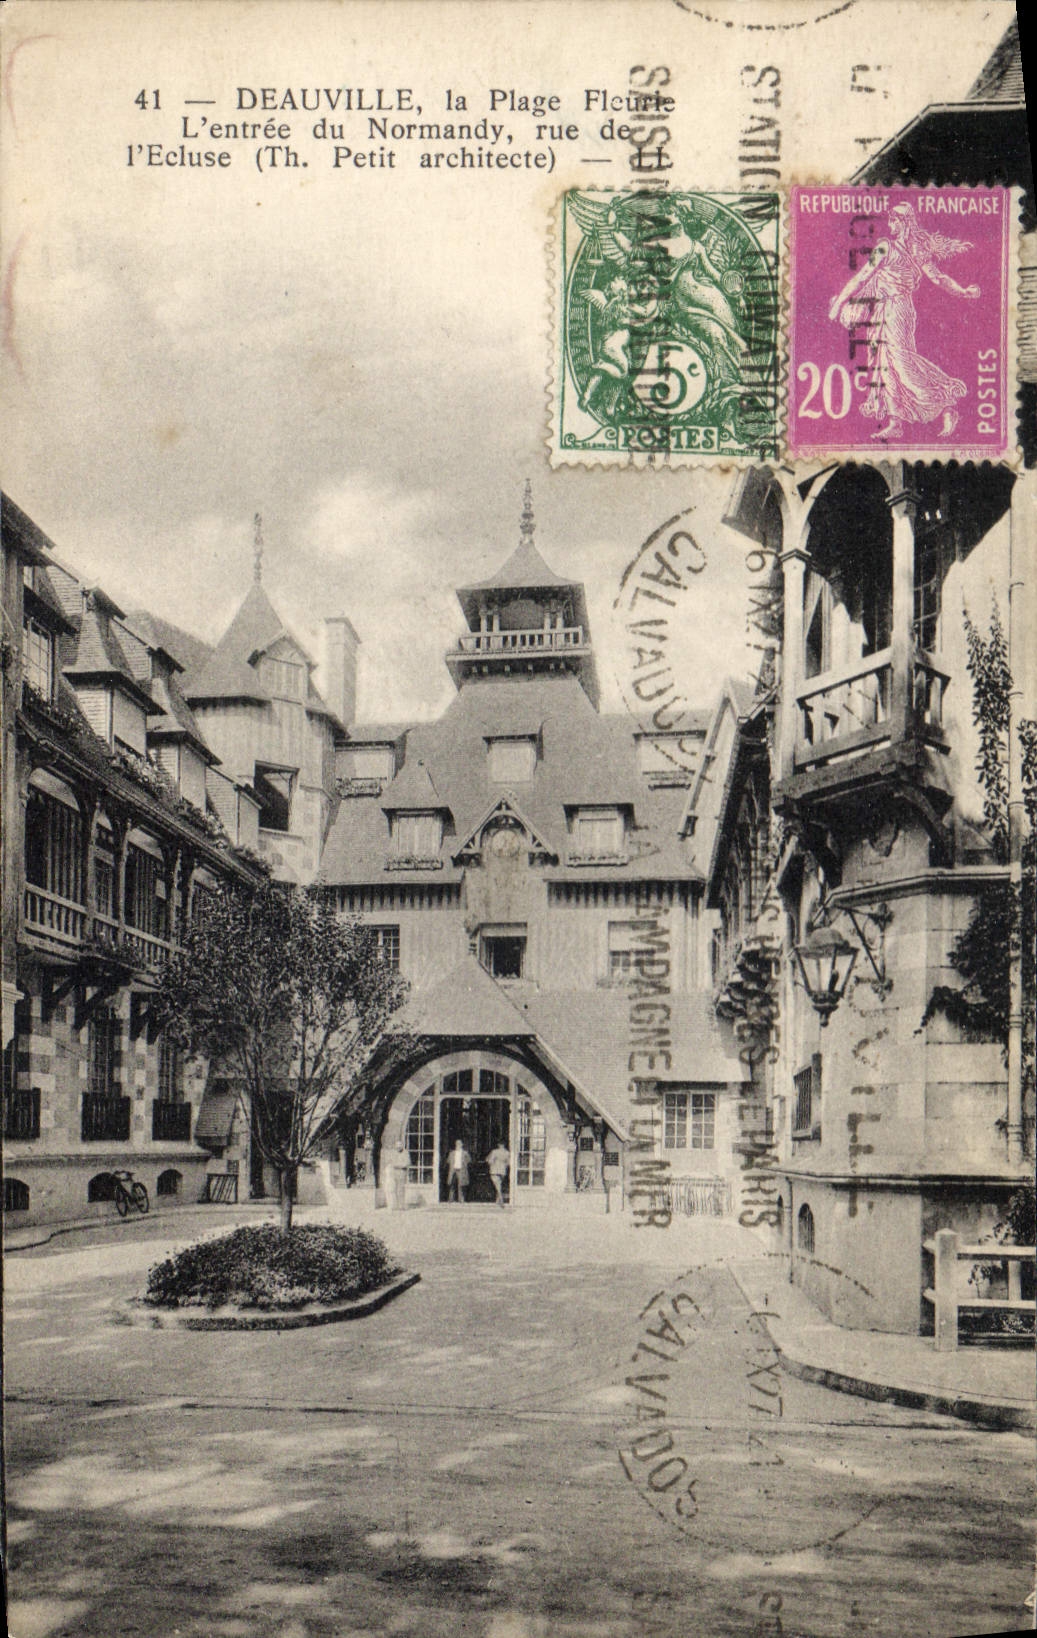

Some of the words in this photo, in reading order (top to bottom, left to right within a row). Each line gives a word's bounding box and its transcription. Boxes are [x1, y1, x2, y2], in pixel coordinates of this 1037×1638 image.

[739, 65, 781, 221] STATION
[917, 195, 1000, 216] FRANÇAISE
[977, 348, 999, 435] POSTES
[621, 426, 716, 450] POSTES
[627, 1161, 671, 1229] MER
[737, 1130, 781, 1228] PARIS
